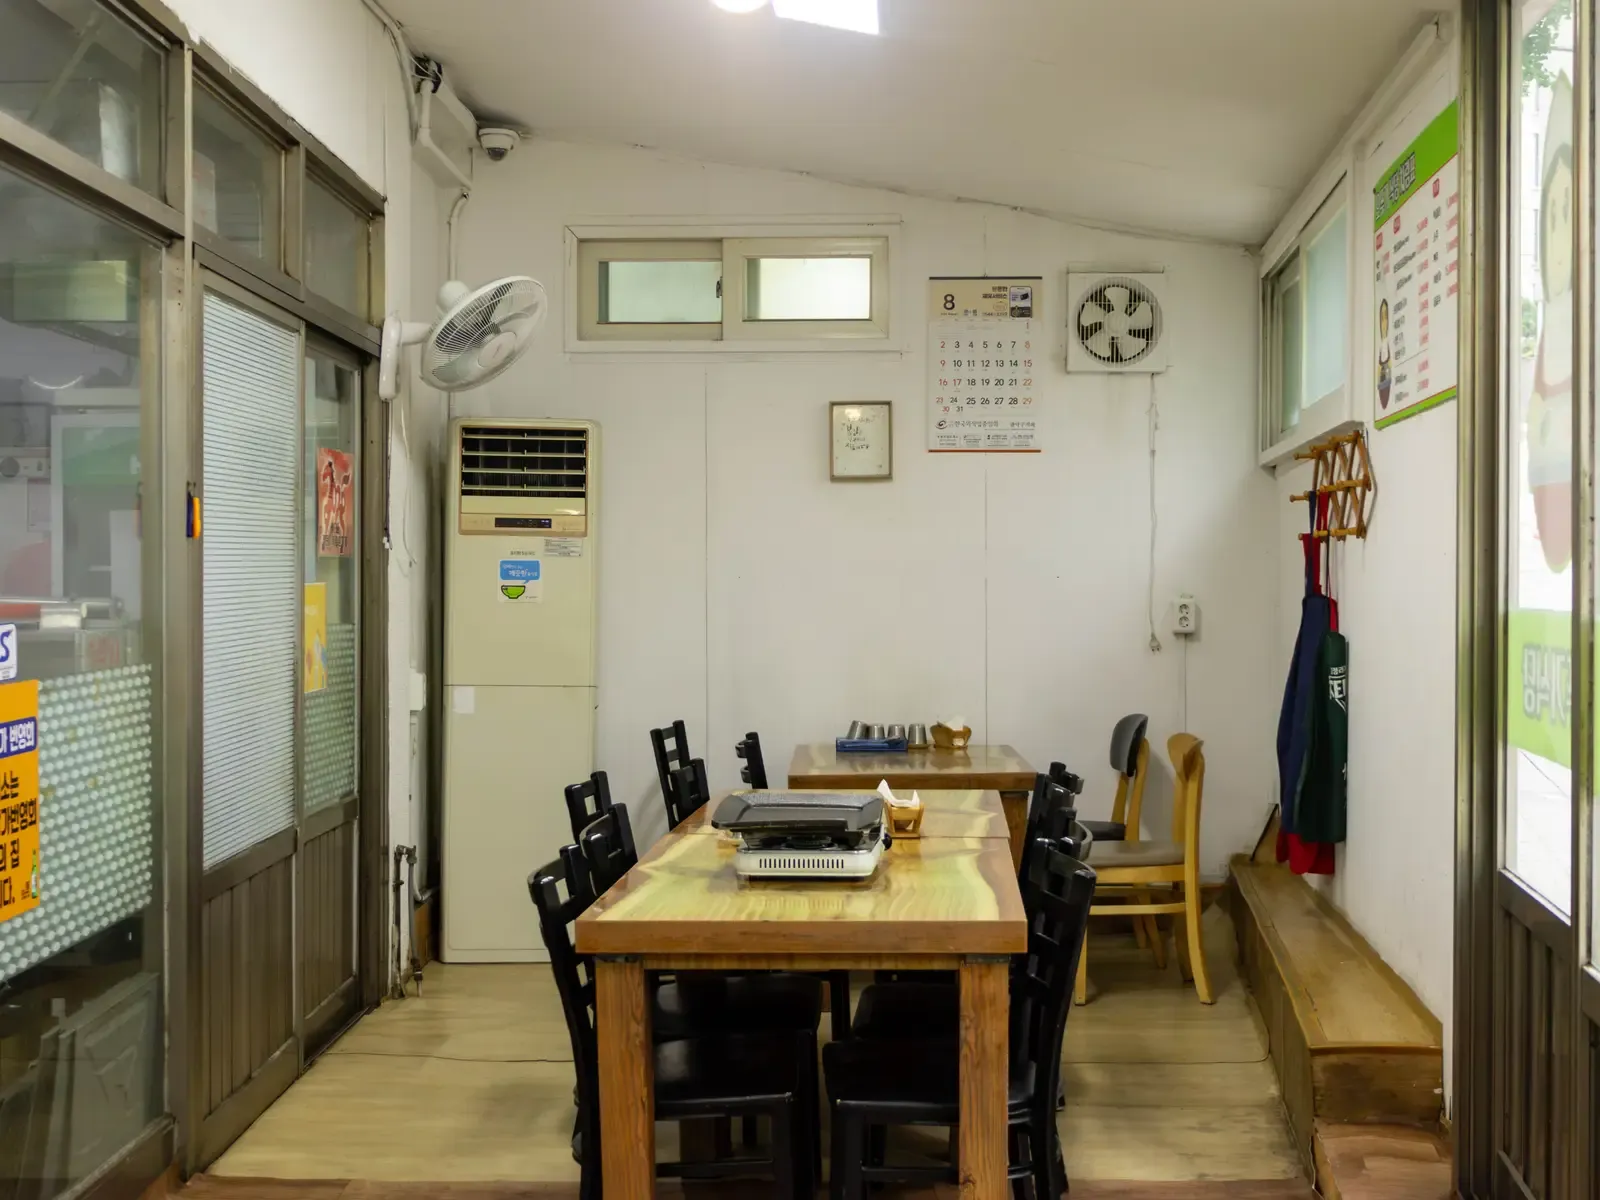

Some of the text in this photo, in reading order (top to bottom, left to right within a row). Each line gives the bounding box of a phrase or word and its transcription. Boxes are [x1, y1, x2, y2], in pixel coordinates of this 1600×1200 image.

[943, 294, 955, 310] 8
[9, 720, 35, 753] 번영회
[10, 838, 19, 869] 집
